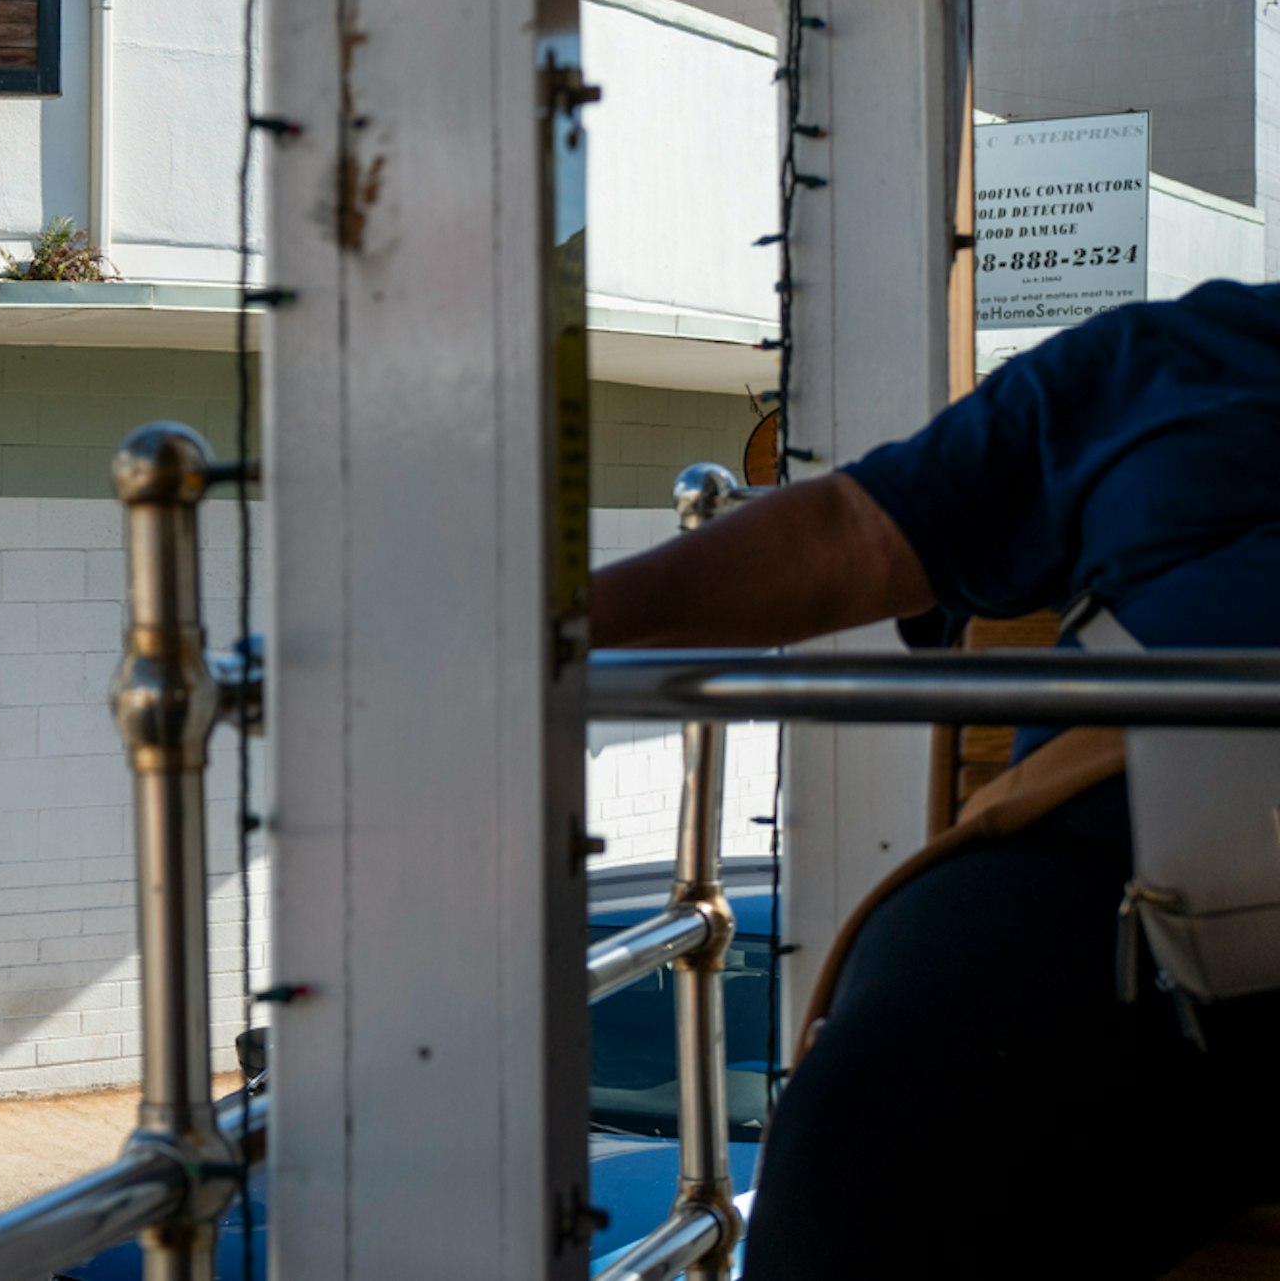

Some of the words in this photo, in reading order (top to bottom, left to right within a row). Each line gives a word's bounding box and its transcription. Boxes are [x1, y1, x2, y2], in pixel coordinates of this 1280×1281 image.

[1013, 125, 1144, 147] ENTERPRISES
[974, 186, 1031, 201] OOFING
[1036, 179, 1142, 196] CONTRACTORS
[974, 207, 1006, 220] OLD
[1012, 202, 1095, 217] DETECTION
[975, 227, 1014, 240] LOOD
[1018, 223, 1079, 238] DAMAGE
[974, 244, 1138, 272] 8-888-2524
[1022, 292, 1043, 302] what
[1046, 290, 1078, 300] matters
[1105, 288, 1114, 297] to
